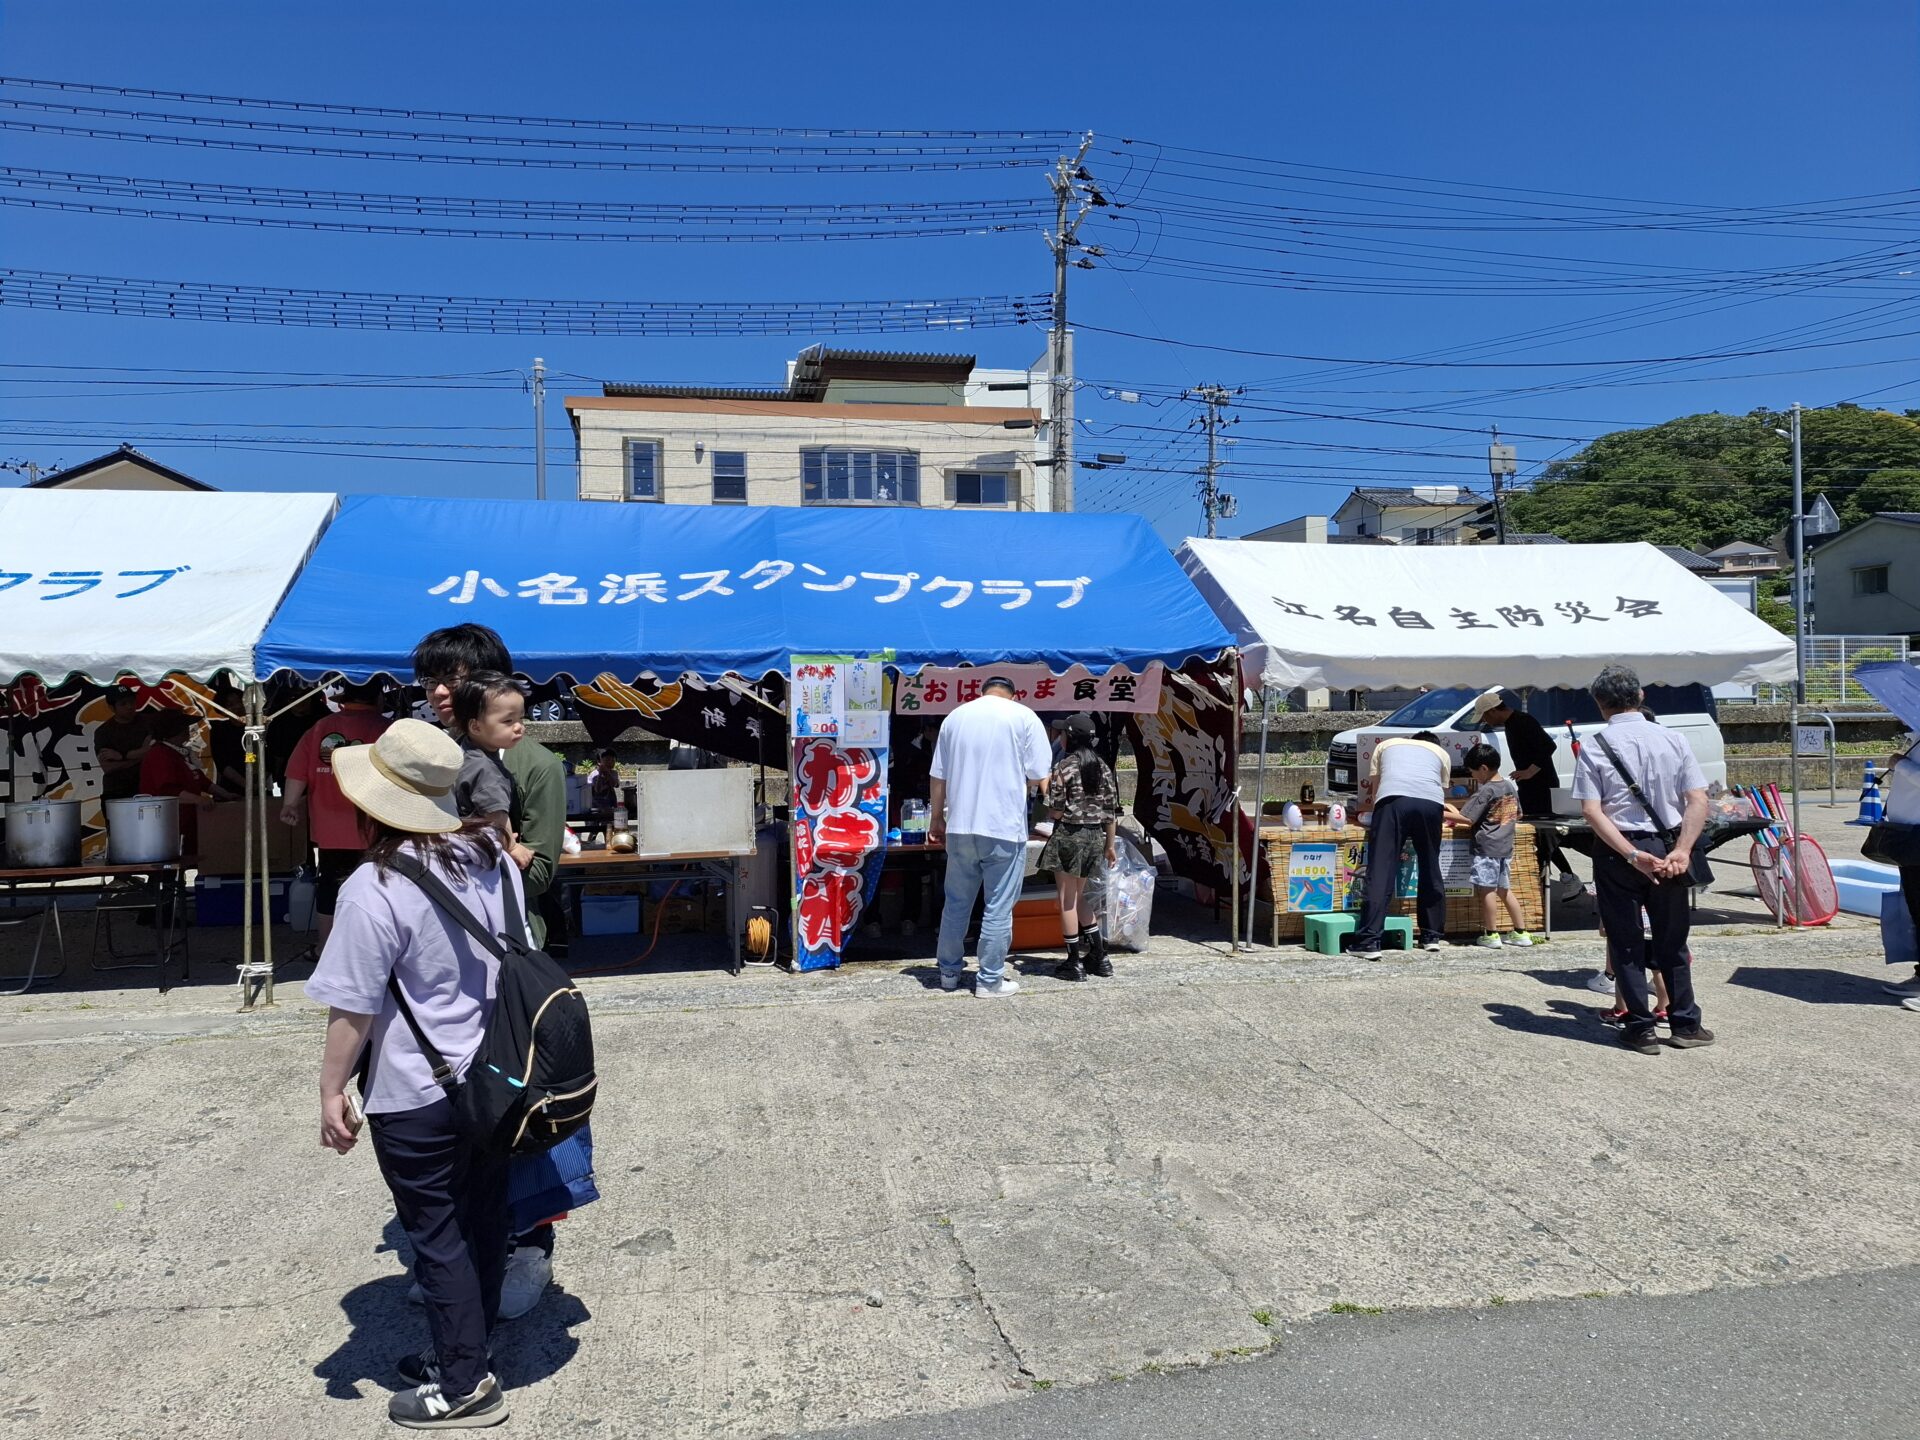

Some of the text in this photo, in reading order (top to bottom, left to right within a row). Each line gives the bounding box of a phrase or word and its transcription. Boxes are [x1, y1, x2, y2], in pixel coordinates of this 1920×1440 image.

[427, 559, 1092, 610] 小名浜スタンプクラブ
[1271, 596, 1663, 631] 江名自主防災会
[923, 677, 1058, 703] おばゃま
[1334, 808, 1342, 819] 3
